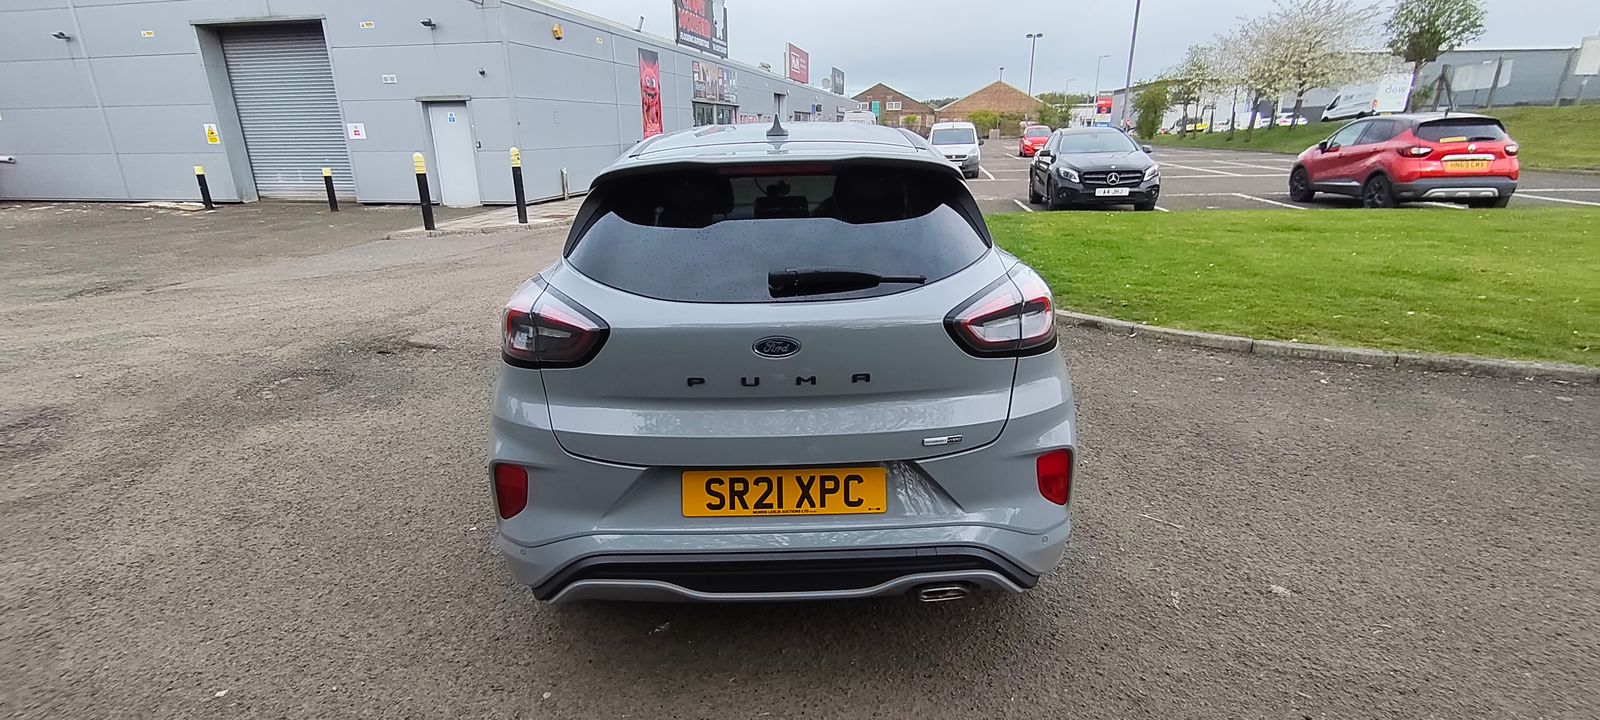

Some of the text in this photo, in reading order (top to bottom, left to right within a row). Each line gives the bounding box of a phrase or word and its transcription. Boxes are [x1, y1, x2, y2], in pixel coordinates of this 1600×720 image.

[763, 341, 790, 353] Ford
[687, 373, 871, 387] PUMA
[705, 474, 864, 511] SR21 XPC
